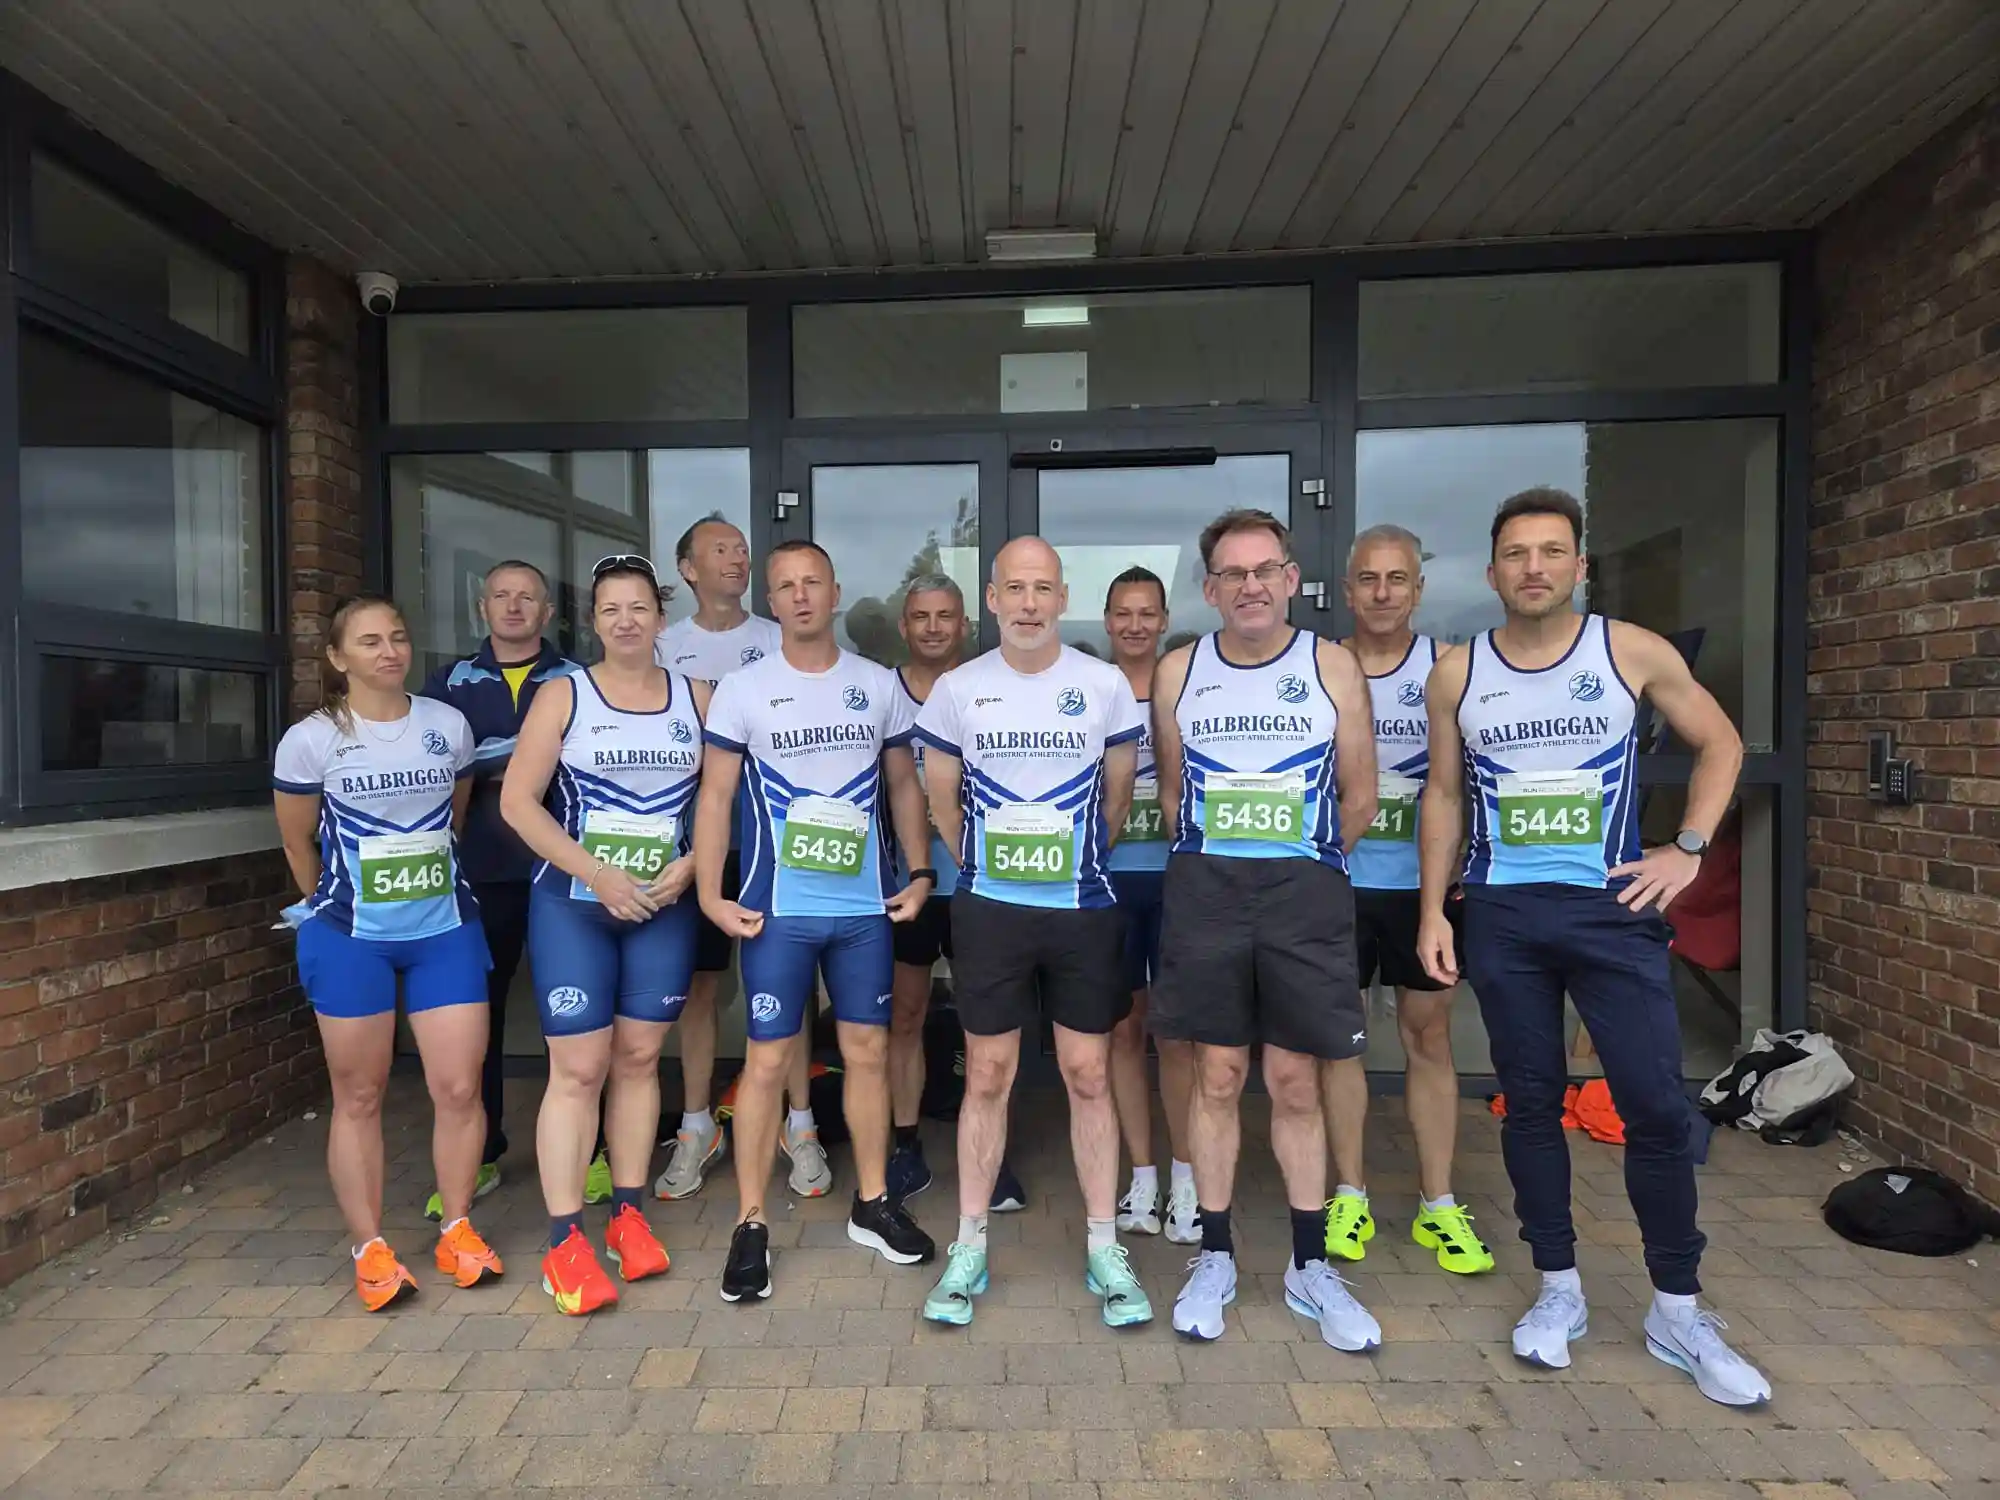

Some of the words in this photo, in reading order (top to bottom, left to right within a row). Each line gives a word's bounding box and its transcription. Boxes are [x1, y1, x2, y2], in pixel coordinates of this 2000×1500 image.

[771, 724, 876, 749] BALBRIGGAN
[1192, 715, 1313, 737] BALBRIGGAN
[1479, 716, 1609, 746] BALBRIGGAN
[793, 747, 822, 757] DISTRICT
[823, 744, 855, 752] ATHLETIC
[975, 731, 1087, 751] BALBRIGGAN
[1507, 741, 1541, 751] DISTRICT
[1542, 739, 1580, 748] ATHLETIC
[594, 749, 696, 766] BALBRIGGAN
[341, 767, 454, 793] BALBRIGGAN
[368, 790, 402, 799] DISTRICT
[404, 788, 436, 796] ATHLETIC
[1215, 802, 1292, 832] 5436
[1510, 807, 1591, 836] 5443
[593, 844, 664, 873] 5445
[791, 834, 858, 866] 5435
[994, 844, 1064, 873] 5440
[373, 862, 444, 895] 5446
